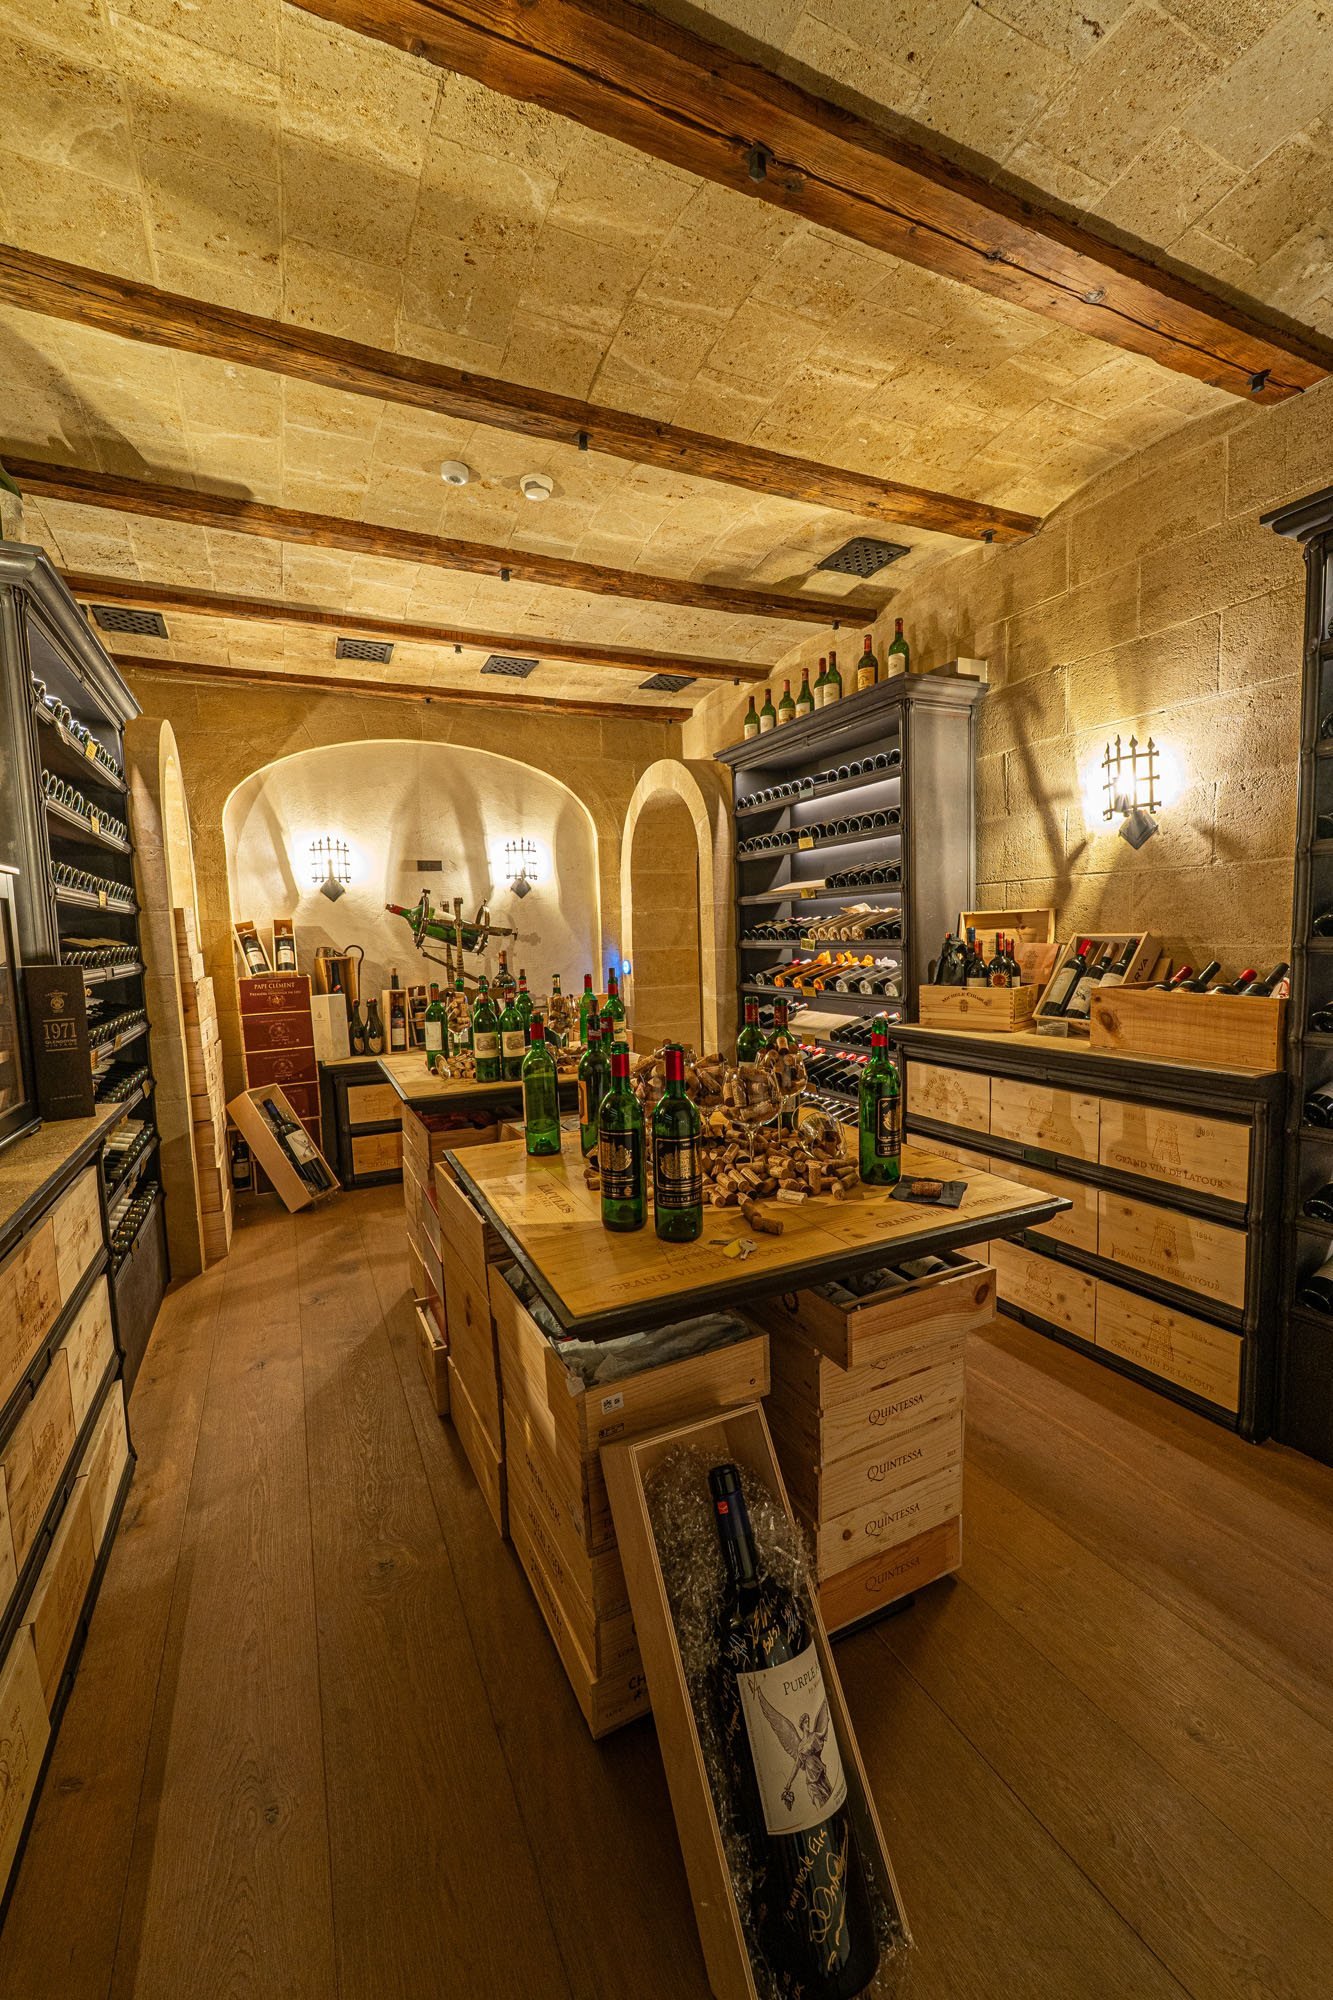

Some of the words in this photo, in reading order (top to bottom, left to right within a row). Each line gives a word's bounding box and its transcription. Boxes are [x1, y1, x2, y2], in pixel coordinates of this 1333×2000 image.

[43, 1022, 78, 1040] 1971
[1115, 1154, 1148, 1170] GRAND
[1150, 1163, 1167, 1175] VIN
[1169, 1167, 1182, 1178] DE
[1183, 1172, 1226, 1190] LATOUR
[875, 1213, 923, 1230] GRAND
[672, 1261, 704, 1277] VIN
[1114, 1247, 1146, 1265] GRAND
[1148, 1259, 1165, 1272] VIN
[1167, 1266, 1180, 1278] DE
[1181, 1271, 1220, 1291] LATOUR
[1110, 1339, 1142, 1359] GRAND
[1143, 1355, 1160, 1368] VIN
[1162, 1363, 1177, 1375] DE
[1177, 1371, 1216, 1393] LATOUR
[869, 1394, 925, 1426] QUINTESSA
[867, 1448, 923, 1482] QUINTESSA
[865, 1502, 921, 1537] QUINTESSA
[782, 1665, 816, 1696] PURPLE
